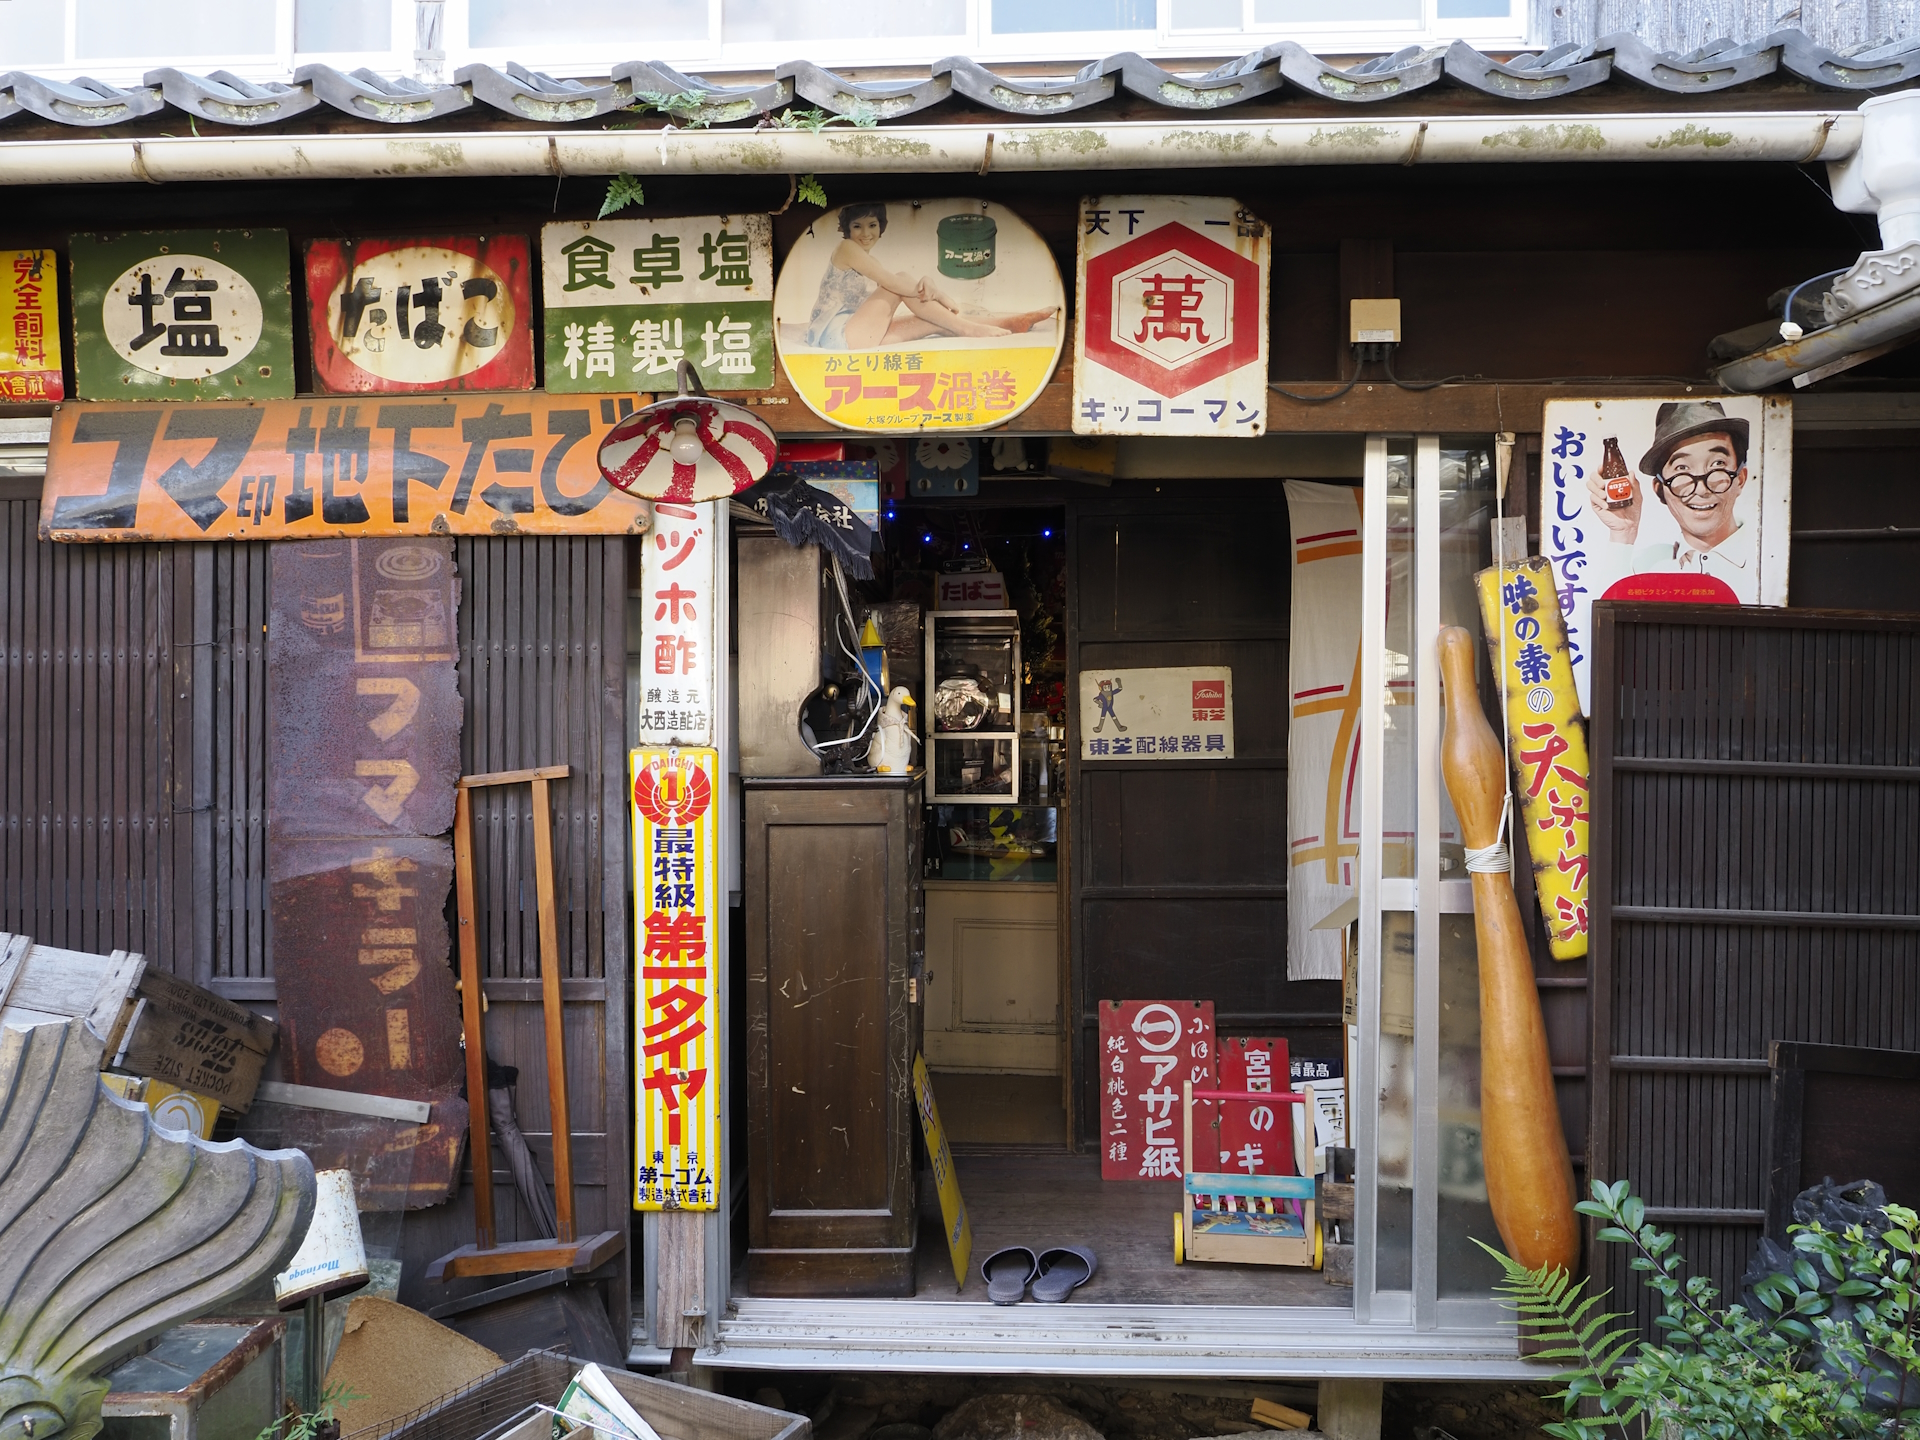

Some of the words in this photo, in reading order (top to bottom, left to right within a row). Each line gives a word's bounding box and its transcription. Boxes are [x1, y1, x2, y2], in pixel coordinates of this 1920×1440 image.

[1085, 210, 1144, 235] 天下
[561, 230, 753, 291] 食卓塩
[13, 257, 46, 366] 完全飼料
[128, 268, 228, 357] 塩
[340, 271, 498, 353] たばこ
[1134, 273, 1212, 344] 萬
[563, 316, 756, 379] 精製塩
[825, 353, 923, 372] かとり線香
[824, 370, 1017, 412] アース渦巻
[1081, 398, 1260, 423] キッコーマン
[54, 398, 633, 531] コマ印地下たび
[941, 580, 1002, 601] たばこ
[1195, 689, 1223, 700] Toshiba
[1193, 709, 1225, 721] 東芝
[1090, 734, 1226, 755] 東芝配線器具
[651, 758, 694, 771] DAIICHI
[186, 1067, 232, 1096] POCKET
[1107, 1036, 1129, 1161] 純白桃色二種
[652, 1150, 698, 1164] 東京
[639, 1166, 712, 1185] 第一ゴム
